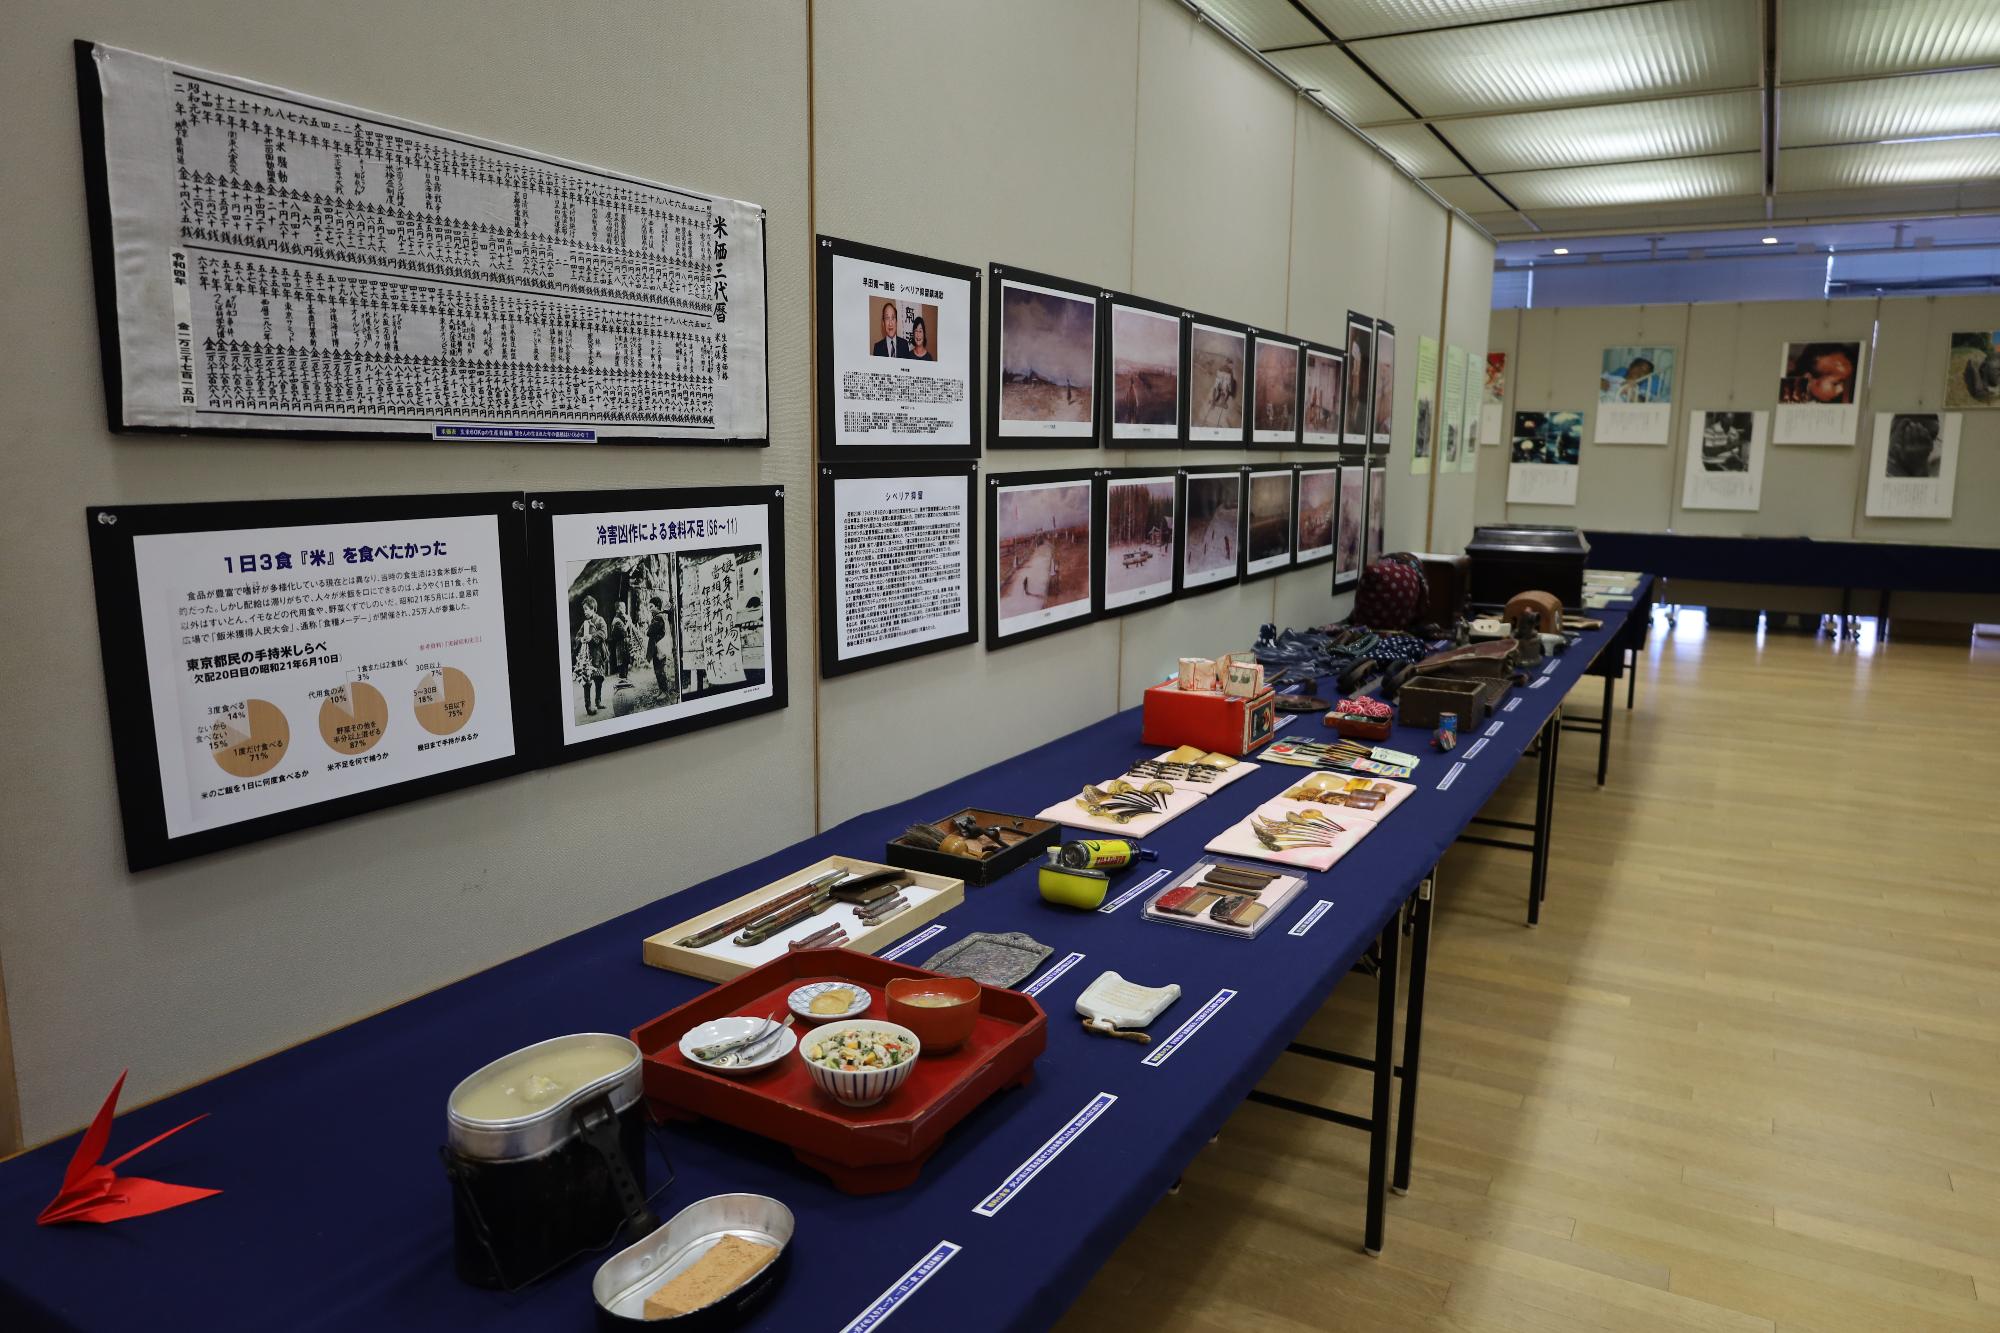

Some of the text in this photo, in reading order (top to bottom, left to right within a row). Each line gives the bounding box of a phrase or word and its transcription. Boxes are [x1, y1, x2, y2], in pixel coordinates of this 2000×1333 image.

[173, 83, 186, 120] 二年
[187, 82, 201, 127] 昭和元年
[200, 90, 213, 123] 十四年
[213, 93, 225, 125] 十三年
[226, 97, 238, 129] 十二年
[238, 99, 249, 132] 十一年
[250, 103, 262, 135] 十年
[262, 106, 274, 137] 九年
[274, 108, 285, 140] 八年
[286, 111, 297, 143] 七年
[298, 114, 309, 146] 六年
[309, 117, 319, 148] 五年
[320, 121, 331, 150] 四年
[332, 123, 342, 152] 三年
[343, 126, 353, 155] 二年
[353, 122, 363, 157] 大正元年
[364, 130, 374, 159] 四十四年
[374, 132, 384, 161] 四十三年
[384, 134, 393, 163] 四十二年
[394, 137, 403, 166] 四十一年
[403, 139, 412, 167] 四十年
[413, 141, 422, 170] 三十九年
[423, 143, 432, 171] 三十八年
[432, 145, 441, 173] 三十七年
[441, 147, 450, 175] 三十六年
[450, 149, 458, 177] 三十五年
[197, 256, 210, 290] 六十一年
[209, 258, 222, 291] 六十年
[222, 260, 234, 292] 五十九年
[234, 261, 246, 293] 五十八年
[246, 262, 258, 295] 五十七年
[258, 264, 269, 296] 五十六年
[269, 266, 280, 297] 五十五年
[712, 213, 729, 323] 米価三代暦
[281, 268, 292, 299] 五十四年
[292, 269, 303, 300] 五十三年
[304, 271, 315, 301] 五十二年
[315, 273, 326, 302] 五十一年
[327, 274, 337, 305] 五十年
[337, 277, 347, 306] 四十九年
[348, 277, 358, 307] 四十八年
[359, 279, 369, 308] 四十七年
[369, 280, 379, 309] 四十六年
[379, 281, 389, 310] 四十五年
[389, 283, 399, 311] 四十四年
[399, 284, 408, 312] 四十三年
[409, 285, 418, 313] 四十二年
[419, 286, 427, 314] 四十一年
[428, 287, 437, 315] 四十年
[437, 288, 446, 316] 三十九年
[446, 289, 455, 317] 三十八年
[456, 290, 464, 318] 三十七年
[464, 292, 473, 319] 三十六年
[473, 293, 481, 320] 三十五年
[171, 251, 195, 403] 令和四年 金一万三千七百一五円
[222, 538, 447, 575] 1日3食『米』を食べたかった
[185, 640, 327, 673] 東京都民の手持米しらべ
[307, 685, 344, 699] 代用食のみ
[329, 693, 346, 704] 10%
[418, 694, 433, 703] 18%
[206, 701, 244, 715] 3度食べる
[227, 710, 245, 721] 14%
[447, 708, 462, 718] 75%
[208, 739, 228, 750] 15%
[233, 738, 283, 756] 1度だけ食べる
[248, 751, 268, 763] 71%
[349, 738, 366, 749] 87%
